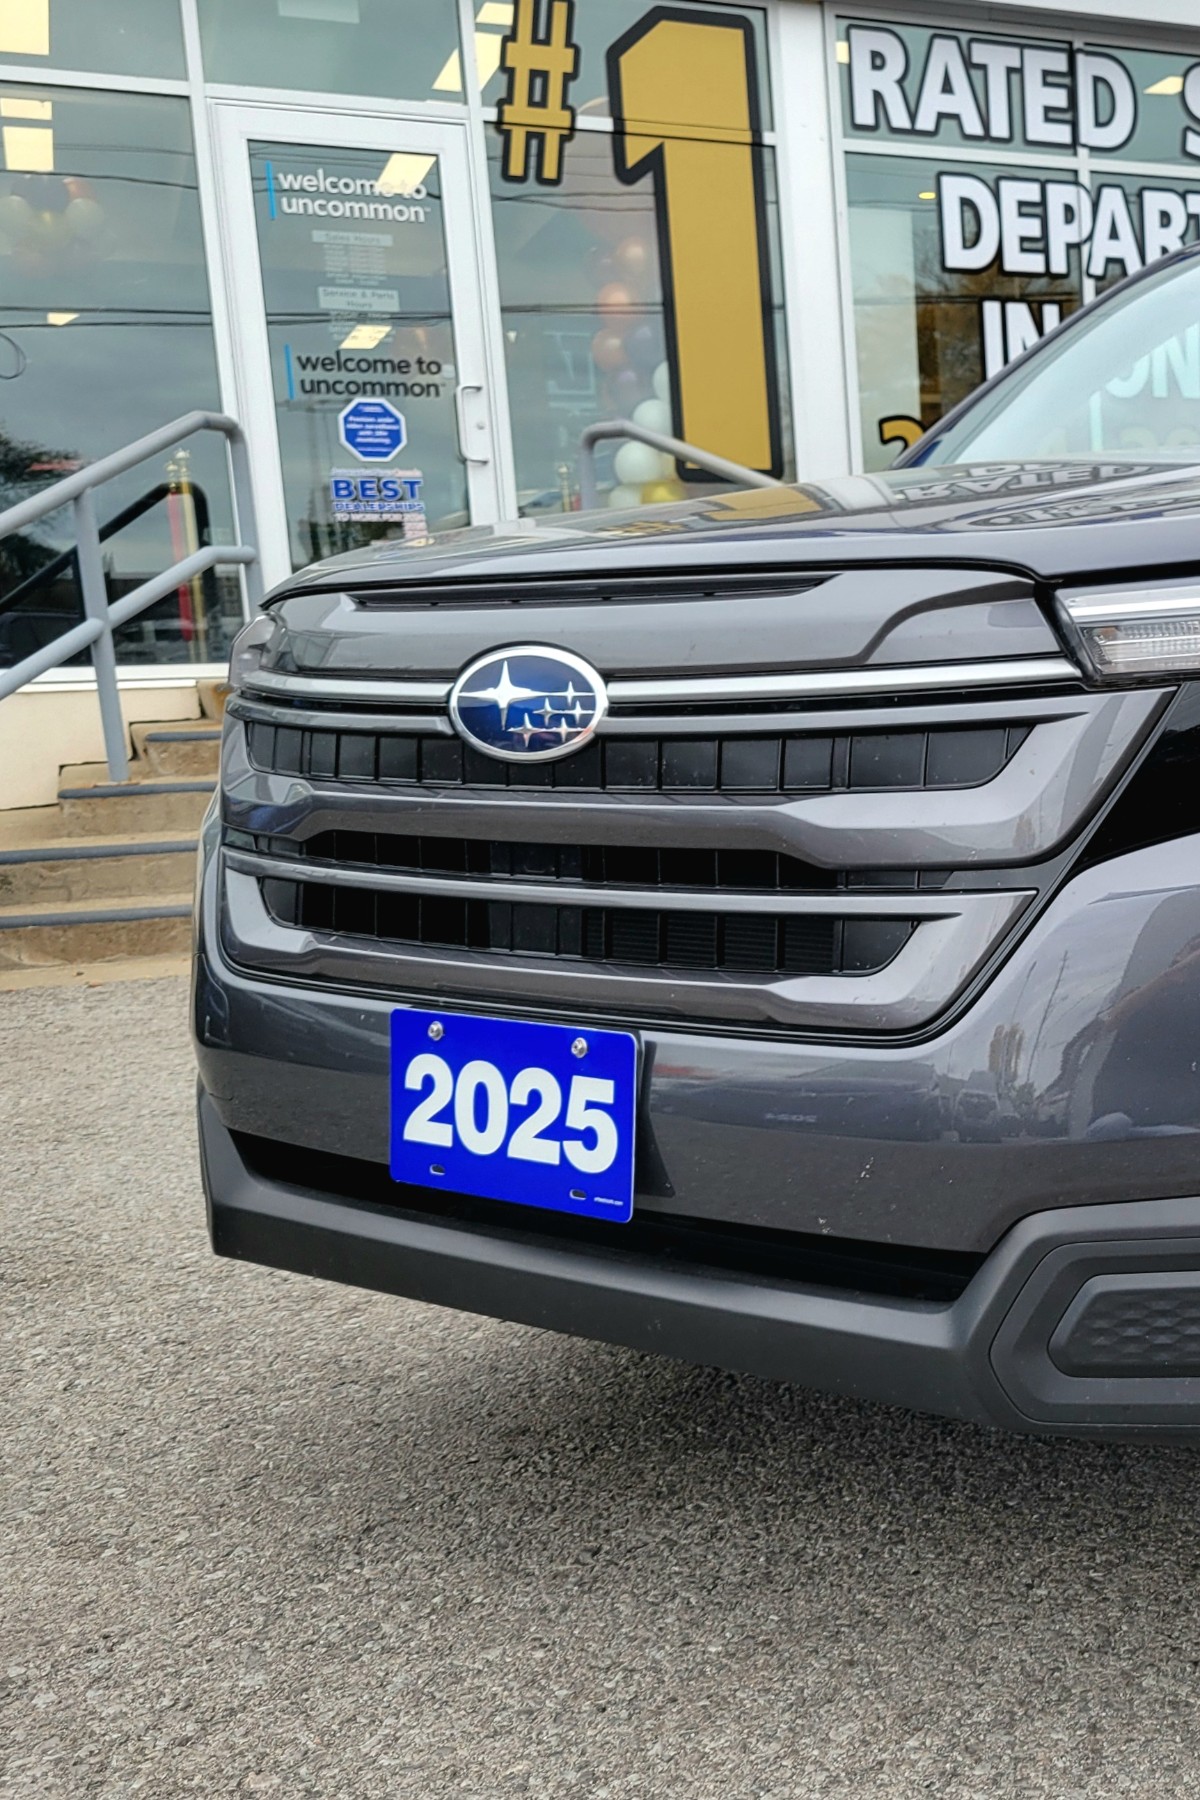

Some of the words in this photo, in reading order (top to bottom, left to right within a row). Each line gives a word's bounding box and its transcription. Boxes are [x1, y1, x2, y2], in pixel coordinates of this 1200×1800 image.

[849, 26, 1137, 149] RATED
[278, 168, 393, 197] welcome
[402, 180, 427, 200] to
[281, 197, 426, 223] uncommon
[297, 350, 411, 374] welcome
[415, 357, 441, 375] to
[300, 379, 440, 397] uncommon
[332, 478, 422, 501] BEST
[334, 501, 425, 512] DEALERSHIPS
[403, 1053, 618, 1174] 2025
